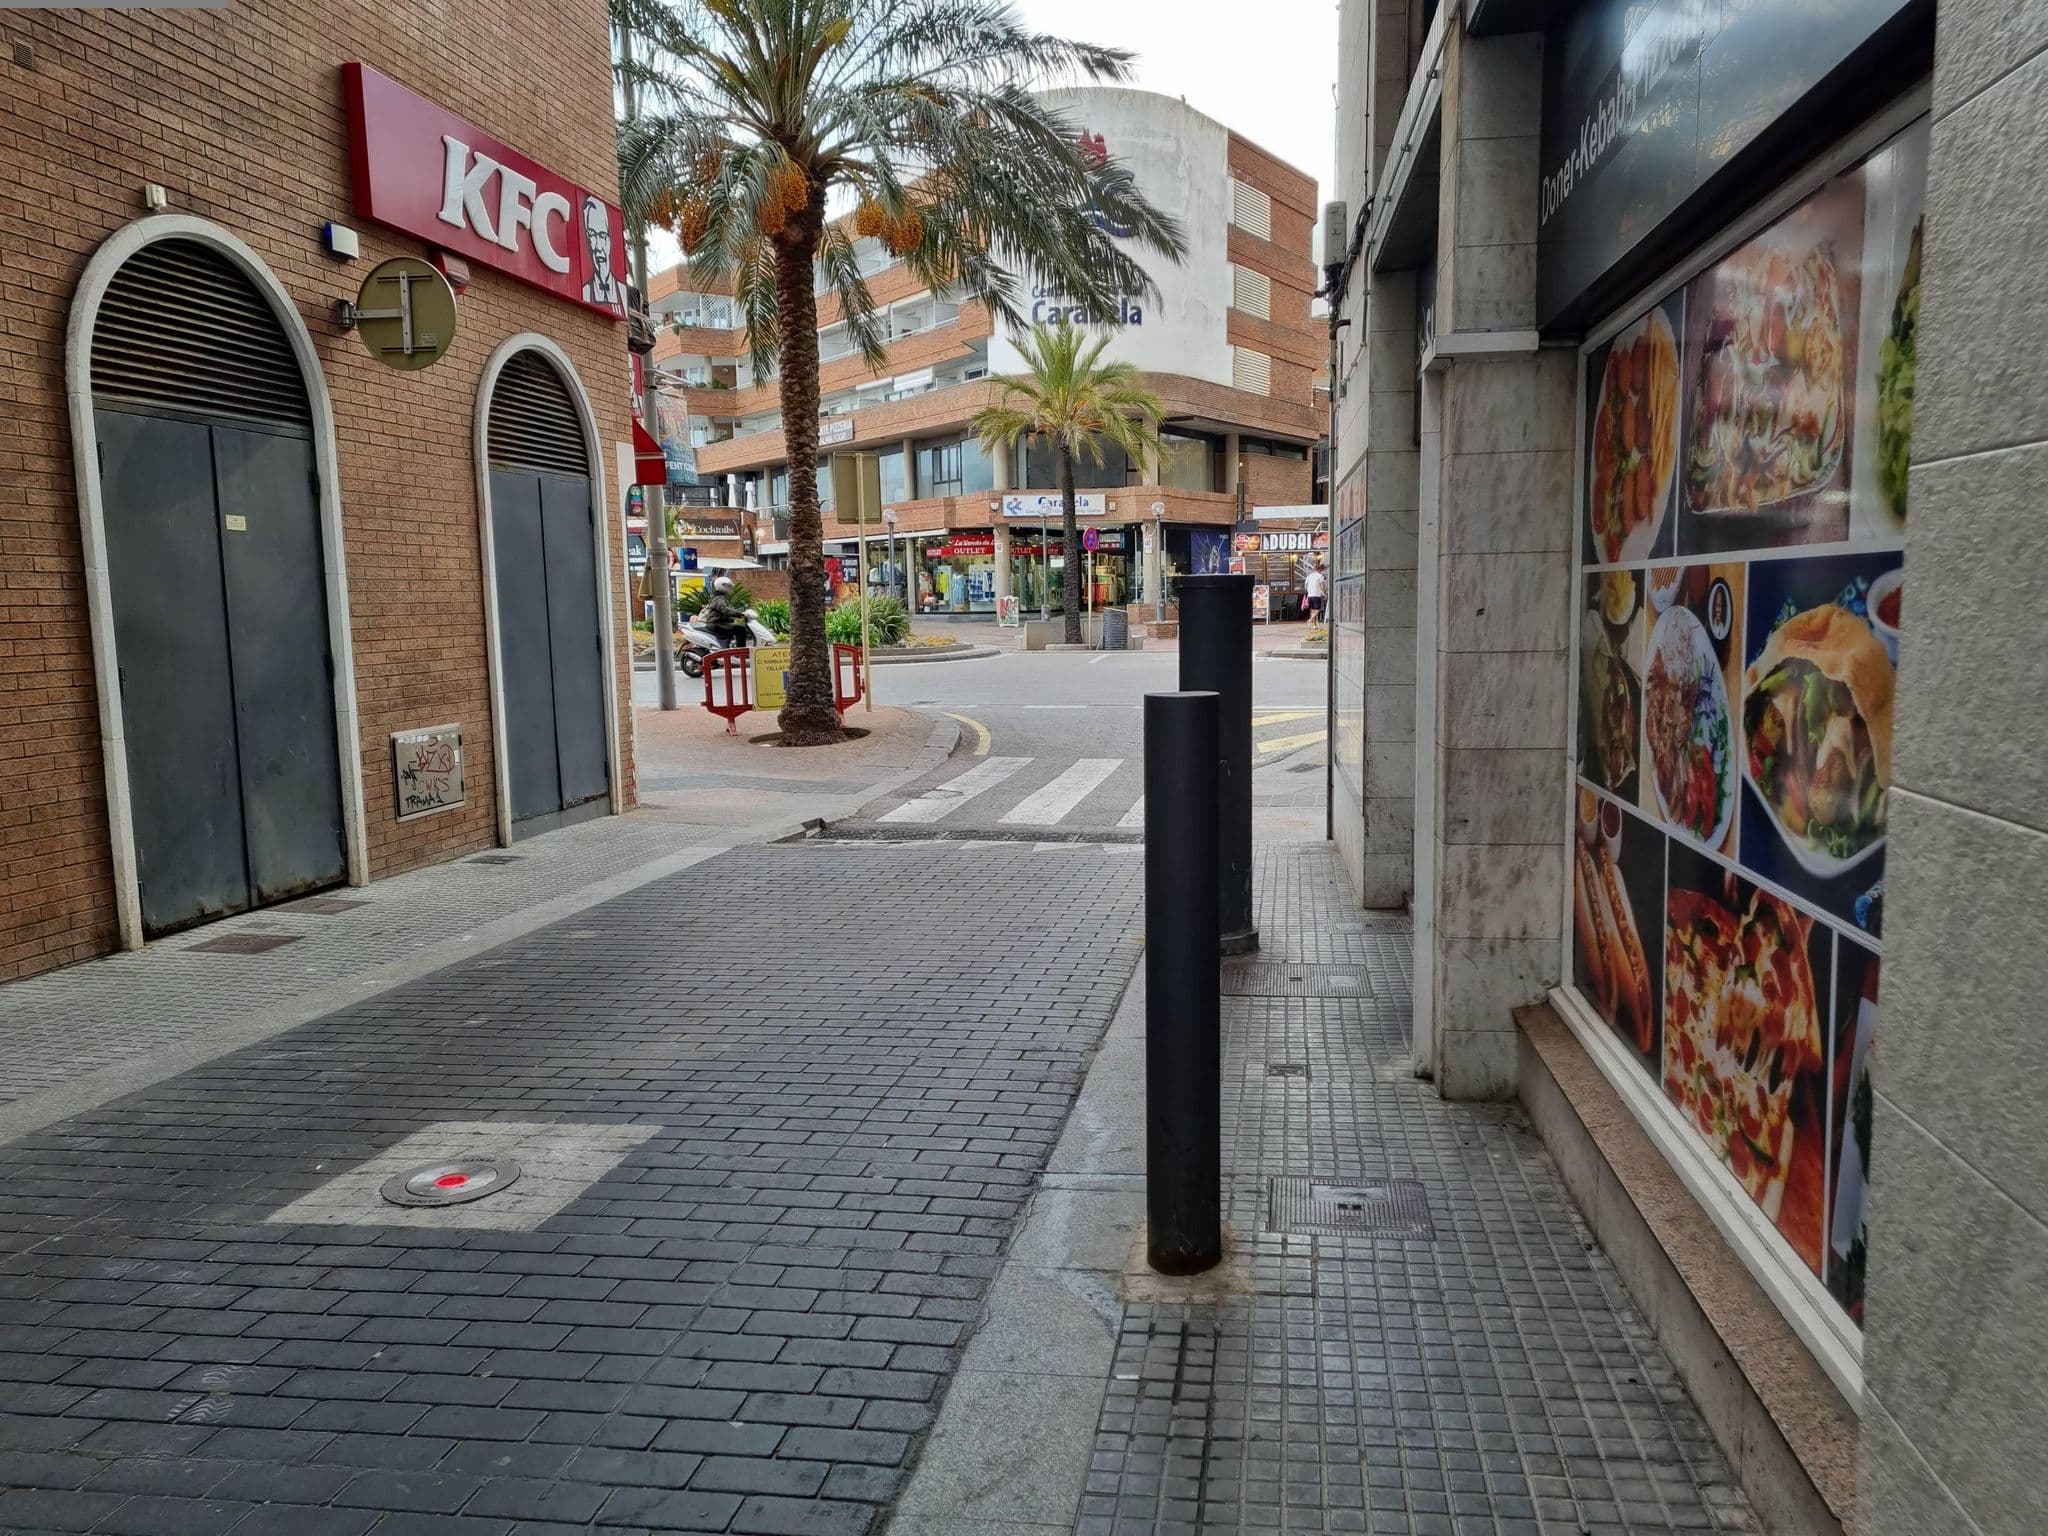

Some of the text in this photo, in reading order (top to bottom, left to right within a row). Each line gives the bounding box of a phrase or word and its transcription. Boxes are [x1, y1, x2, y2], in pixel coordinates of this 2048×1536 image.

[438, 135, 570, 274] KFC
[1270, 533, 1312, 550] DUBAI
[953, 547, 986, 555] OUTLET
